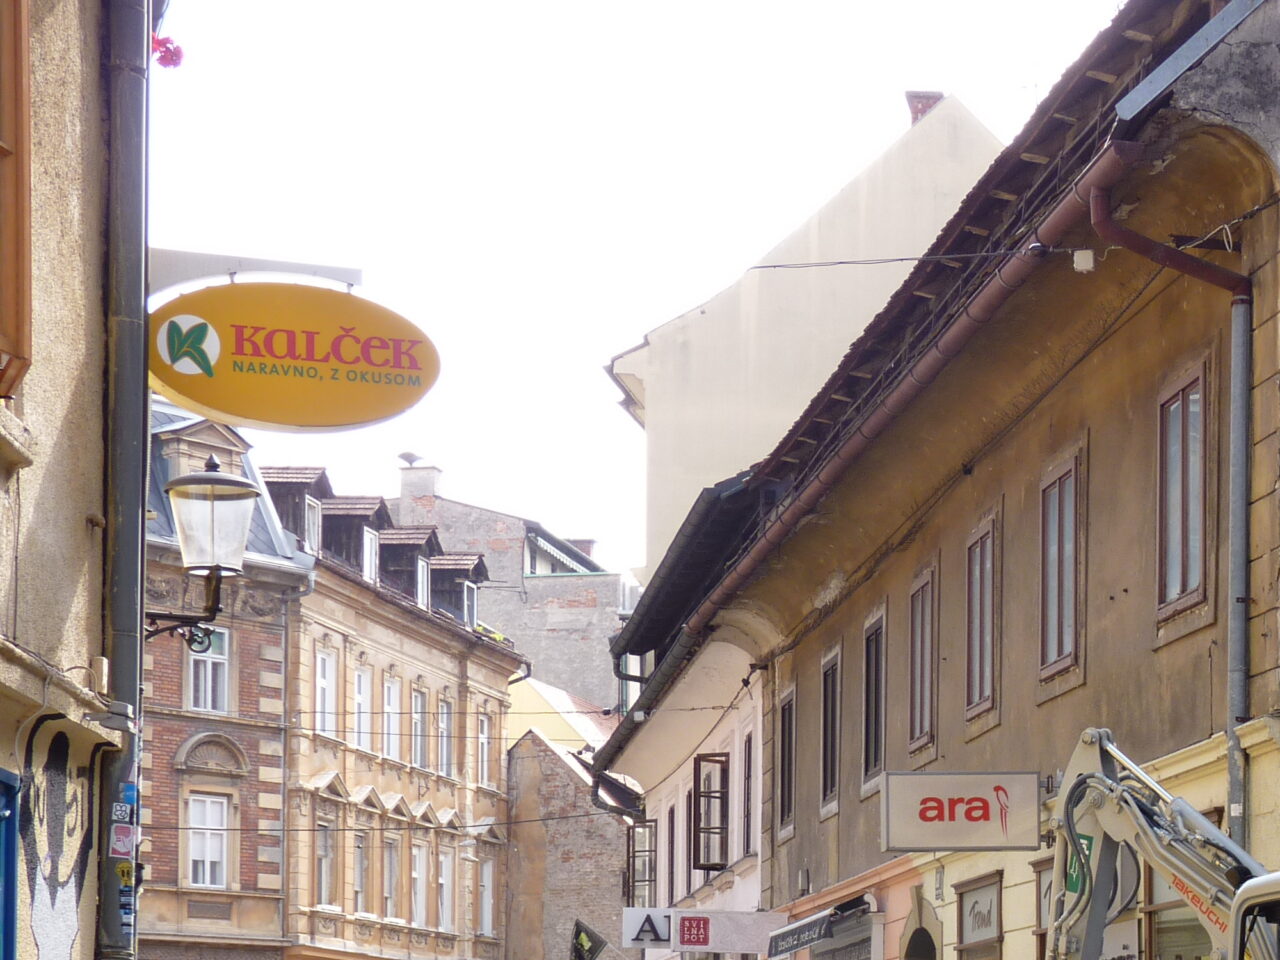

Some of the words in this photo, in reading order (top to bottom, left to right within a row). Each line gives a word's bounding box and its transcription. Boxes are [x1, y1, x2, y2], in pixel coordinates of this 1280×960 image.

[232, 360, 324, 381] NARAVNO,
[330, 368, 340, 381] Z
[346, 370, 422, 387] OKUSOM
[918, 796, 991, 822] ara
[968, 898, 993, 934] Trend
